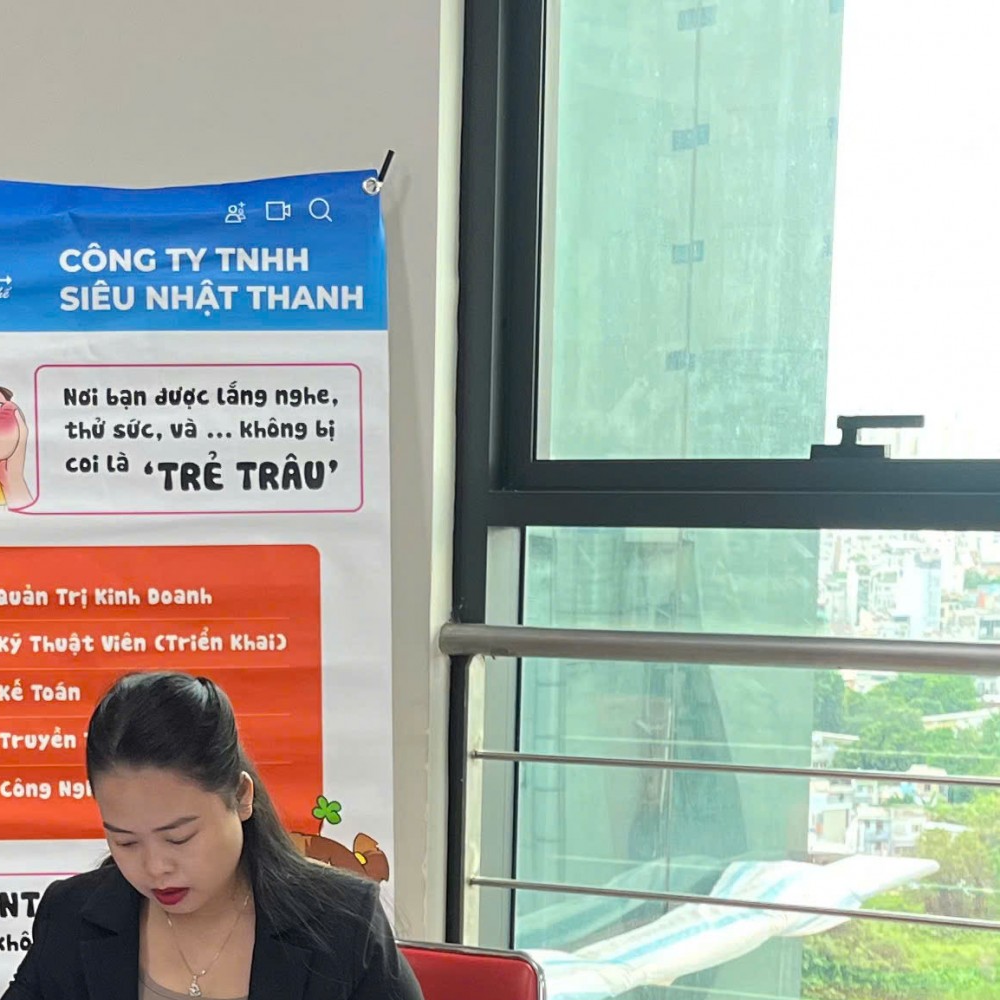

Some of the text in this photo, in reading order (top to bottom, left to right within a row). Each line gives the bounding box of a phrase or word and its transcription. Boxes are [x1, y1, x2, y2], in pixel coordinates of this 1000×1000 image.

[59, 242, 309, 273] CÔNG TY TNHH
[59, 279, 364, 317] SIÊU NHẬT THANH
[63, 381, 339, 410] Nơi bạn được lắng nghe,
[64, 417, 106, 439] thử
[113, 418, 163, 442] sức,
[170, 418, 198, 439] và
[240, 418, 308, 441] không
[315, 419, 336, 442] bị
[65, 455, 99, 473] coi
[106, 451, 130, 473] là
[55, 587, 88, 610] Trị
[94, 587, 141, 606] Kinh
[147, 587, 213, 605] Doanh
[29, 632, 95, 656] Thuật
[101, 631, 147, 653] Viên
[154, 626, 223, 652] (Triển
[230, 632, 288, 652] Khai)
[30, 681, 81, 702] Toán
[0, 777, 52, 800] Công
